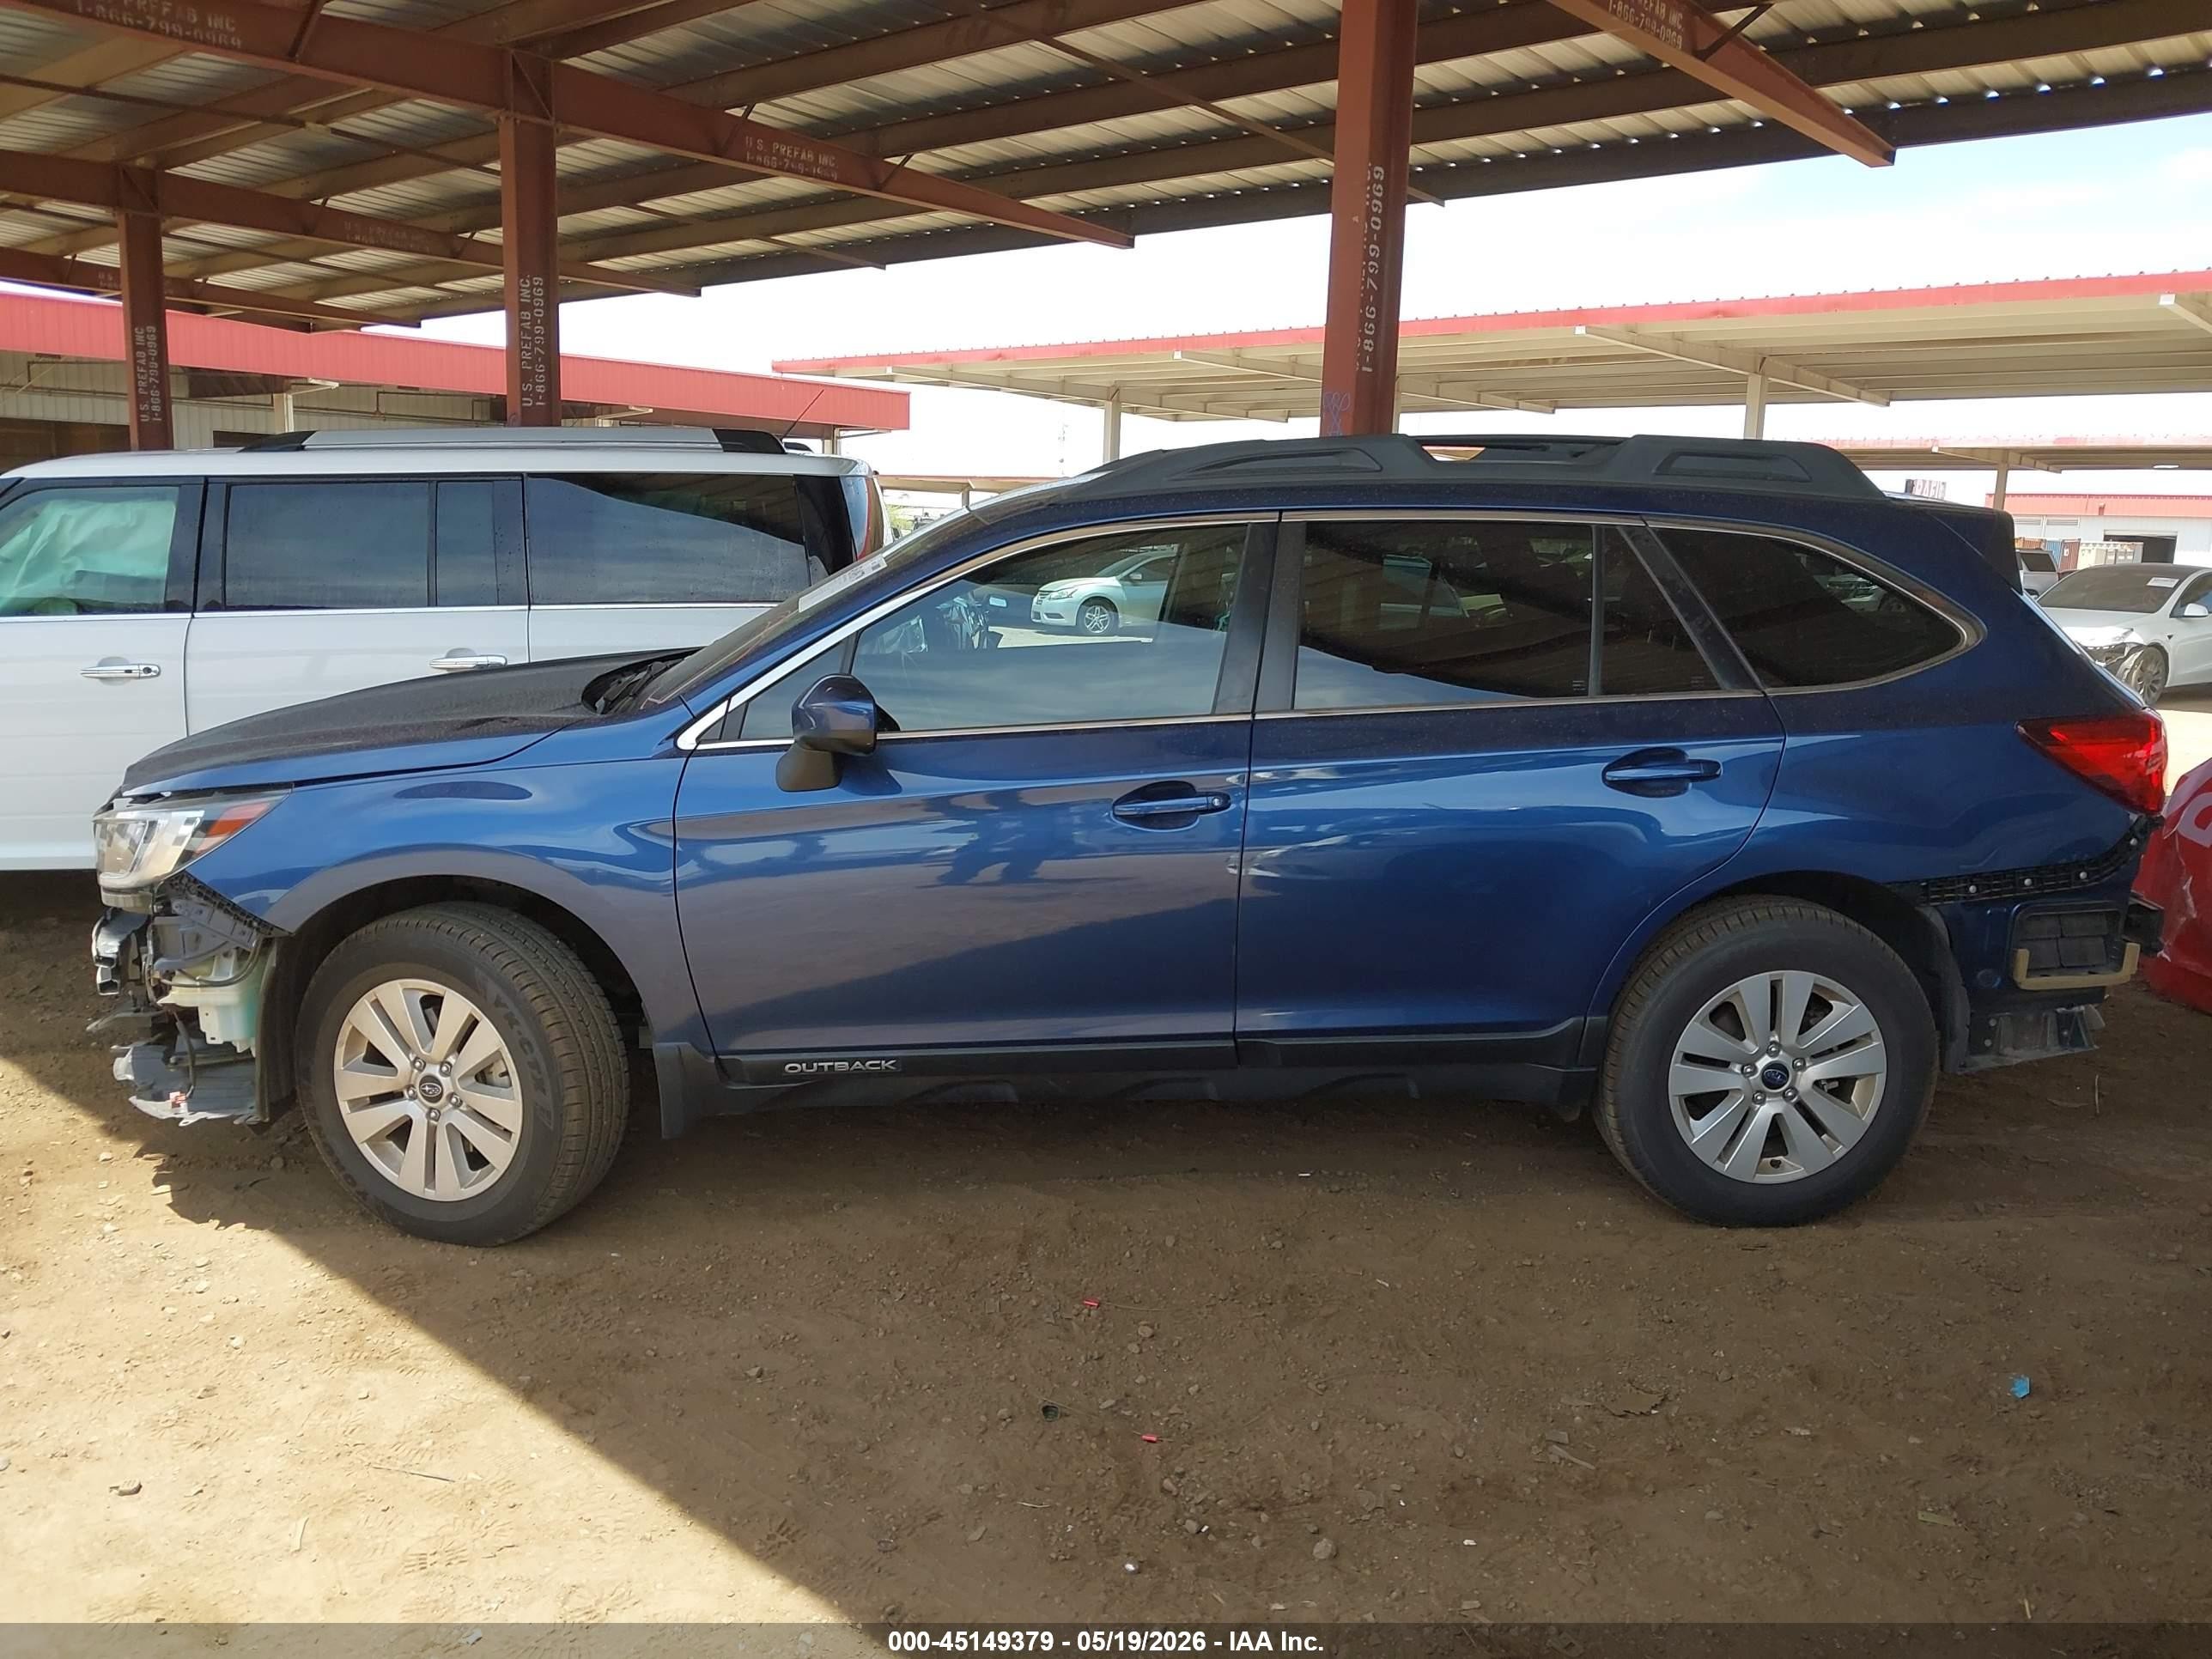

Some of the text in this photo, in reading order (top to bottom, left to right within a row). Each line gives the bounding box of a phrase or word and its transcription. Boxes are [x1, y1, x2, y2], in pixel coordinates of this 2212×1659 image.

[745, 150, 839, 181] 1-66-79-99
[772, 142, 815, 162] PREFAB
[1361, 166, 1385, 373] 1-866-799-0969
[519, 275, 531, 303] INC.
[520, 311, 532, 369] PREFAB
[532, 276, 546, 405] 1-866-799-0969
[784, 1059, 898, 1073] OUTBACK
